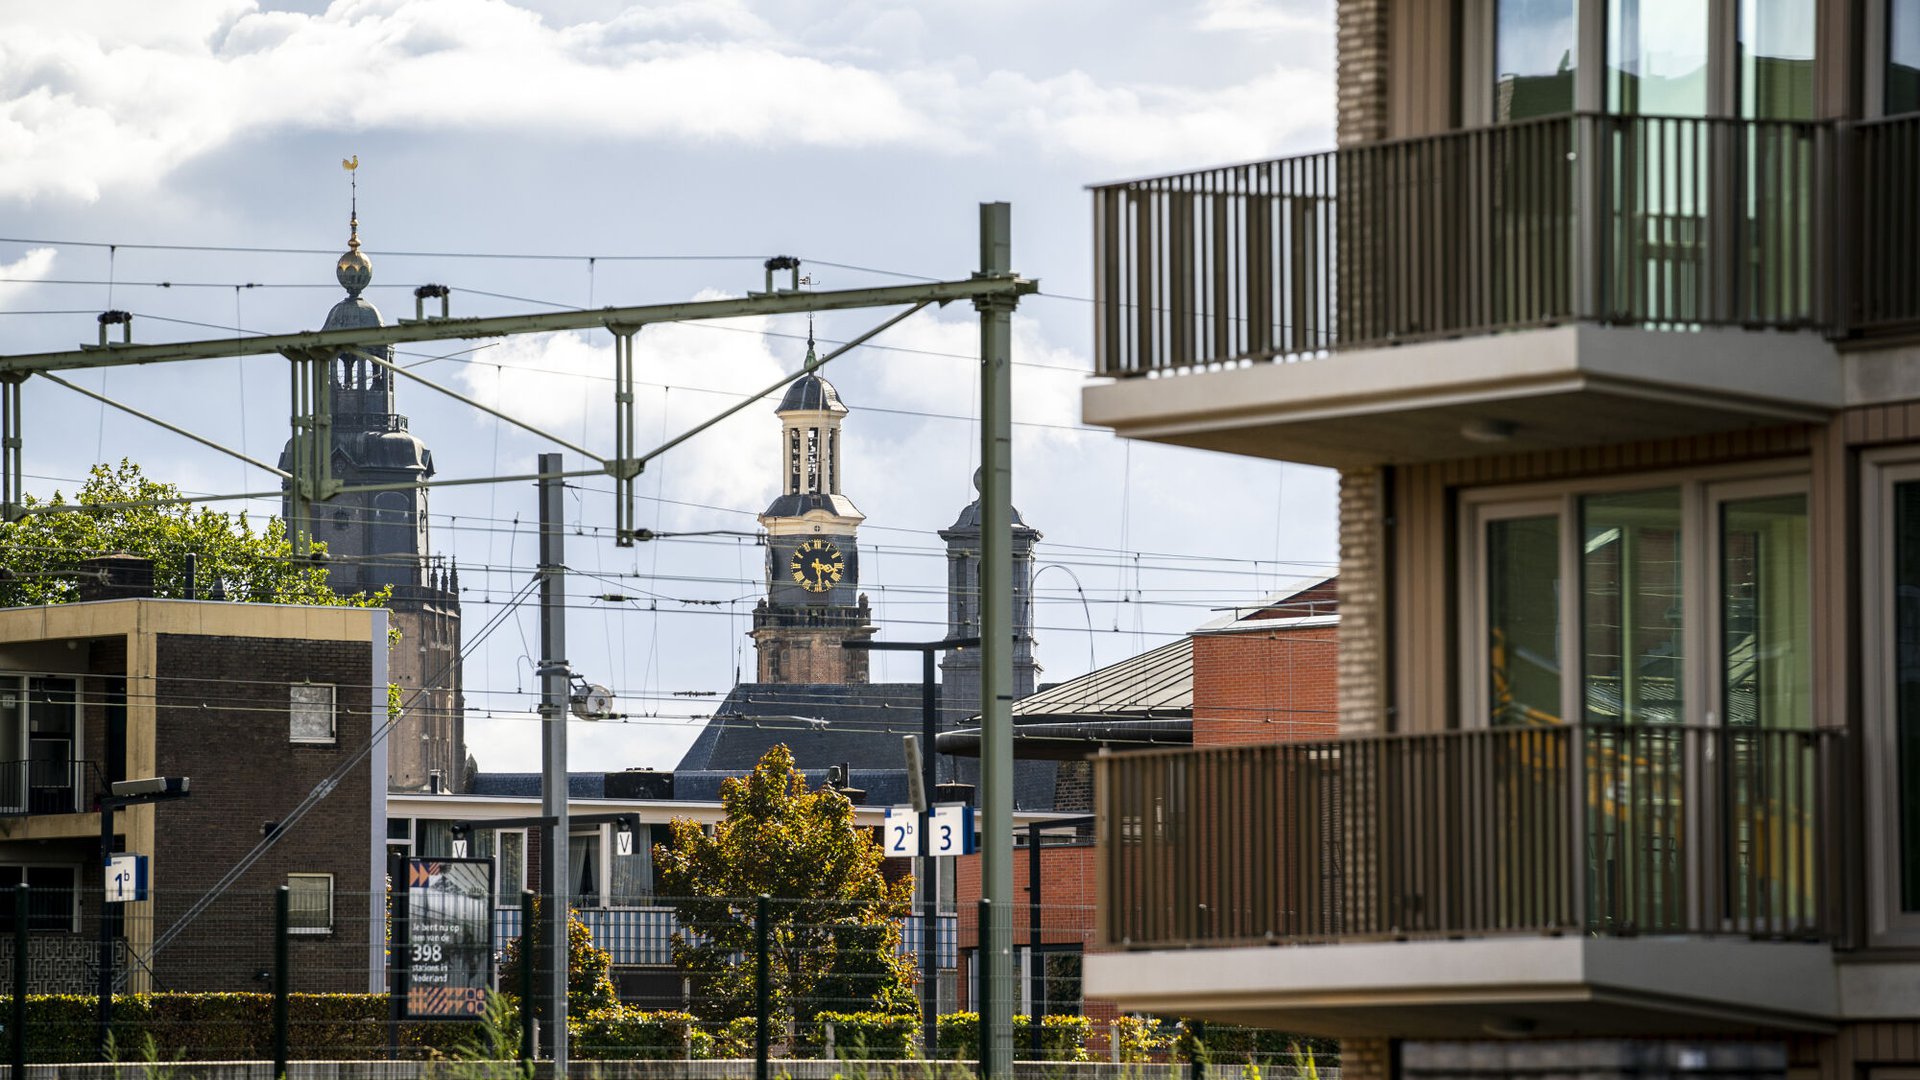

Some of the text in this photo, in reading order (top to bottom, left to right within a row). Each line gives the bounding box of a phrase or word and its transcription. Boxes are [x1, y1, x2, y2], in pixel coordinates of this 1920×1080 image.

[619, 833, 630, 853] V
[940, 825, 952, 851] 3
[454, 841, 466, 858] V
[421, 922, 438, 932] bent
[439, 924, 449, 932] nu
[449, 924, 460, 934] op
[427, 934, 440, 942] van
[440, 932, 450, 942] de
[411, 943, 442, 962] 398
[411, 963, 448, 972] stations in
[411, 973, 448, 983] Nederland
